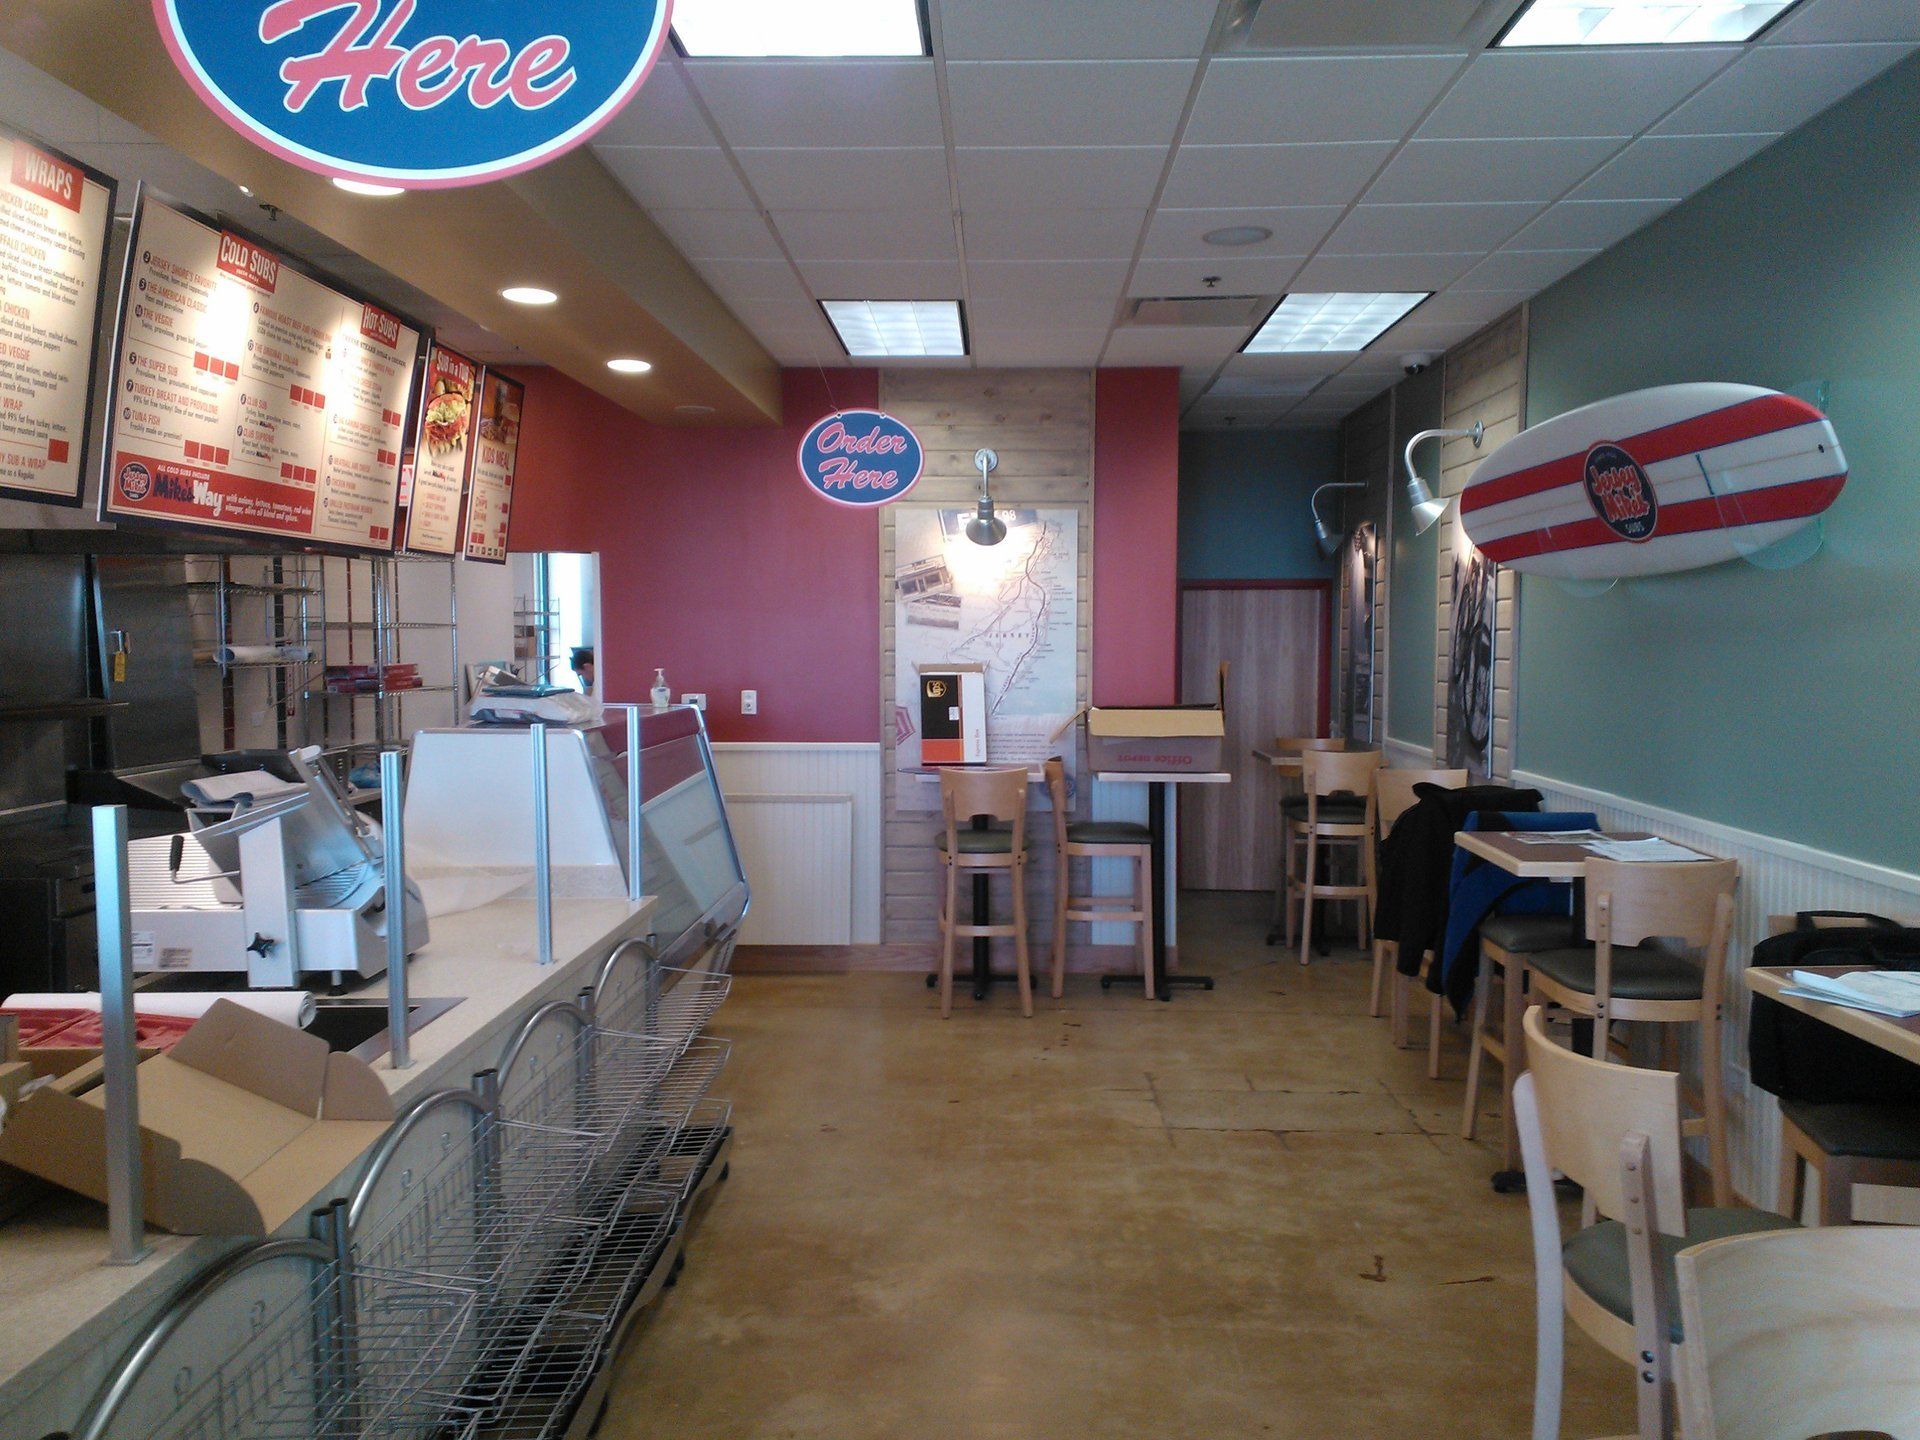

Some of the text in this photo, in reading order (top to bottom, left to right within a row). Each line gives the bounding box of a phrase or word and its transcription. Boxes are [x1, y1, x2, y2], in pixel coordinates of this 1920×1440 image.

[258, 0, 577, 112] Here
[25, 152, 73, 200] WRAPS
[221, 235, 249, 268] COLD
[250, 249, 276, 285] SUBS
[4, 301, 30, 321] CHICKEN
[143, 308, 154, 320] THE
[154, 312, 174, 327] VEGGIE
[363, 306, 378, 331] HOT
[378, 314, 398, 342] SUBS
[9, 344, 31, 361] VEGGIE
[437, 350, 450, 372] SUB
[137, 355, 148, 367] THE
[149, 359, 167, 373] SUPER
[167, 365, 178, 376] SUB
[3, 397, 23, 411] WRAP
[134, 382, 156, 398] TURKEY
[156, 388, 177, 403] BREAST
[178, 396, 190, 407] AND
[190, 398, 219, 415] PROVOLONE
[131, 409, 147, 422] TUNA
[147, 413, 161, 426] FISH
[817, 421, 908, 454] Order
[8, 453, 20, 466] SUB
[21, 456, 26, 468] A
[28, 457, 47, 470] WRAP
[157, 464, 166, 472] ALL
[166, 465, 180, 475] COLD
[180, 468, 192, 477] SUBS
[123, 467, 148, 482] Jersey
[818, 456, 899, 490] Here
[1589, 464, 1642, 497] Jersey
[153, 472, 224, 517] Mike's Way
